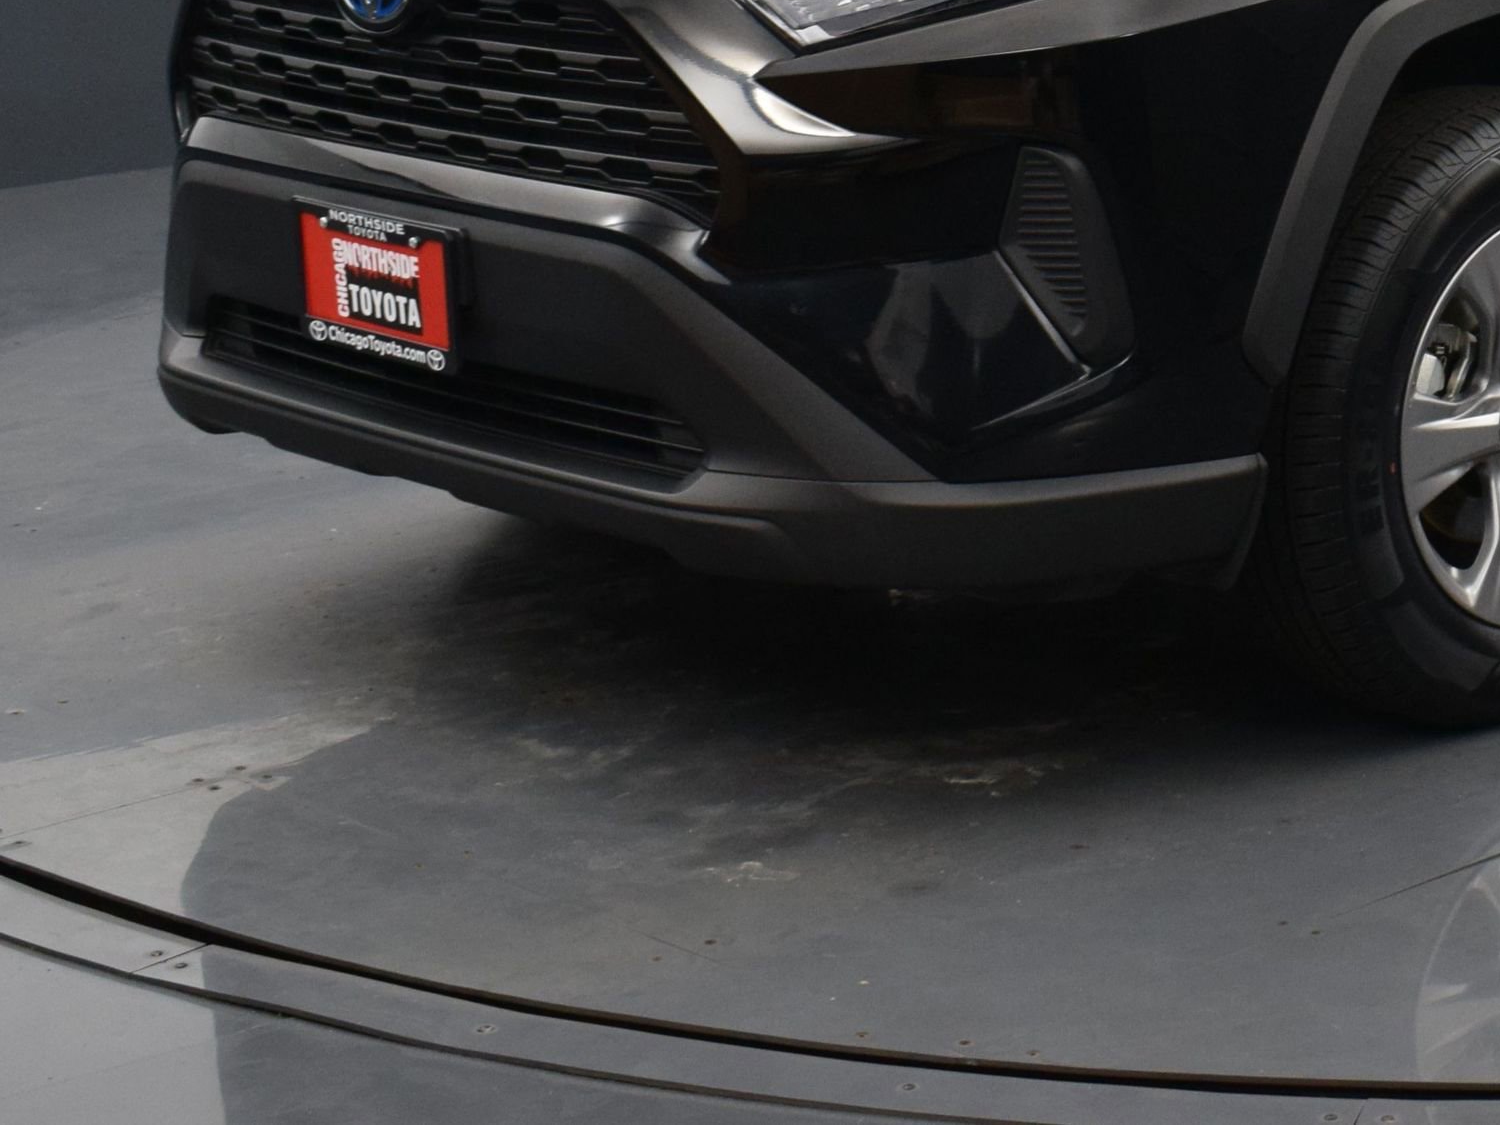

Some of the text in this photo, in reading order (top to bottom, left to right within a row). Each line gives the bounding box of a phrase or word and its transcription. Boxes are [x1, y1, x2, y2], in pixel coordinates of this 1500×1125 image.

[328, 209, 405, 235] NORTHSIDE
[346, 224, 387, 242] TOYOTA
[331, 237, 350, 317] CHICAGO
[343, 240, 420, 279] NORTHSIDE
[348, 283, 421, 328] TOYOTA
[328, 325, 427, 363] ChicagoToyota.com
